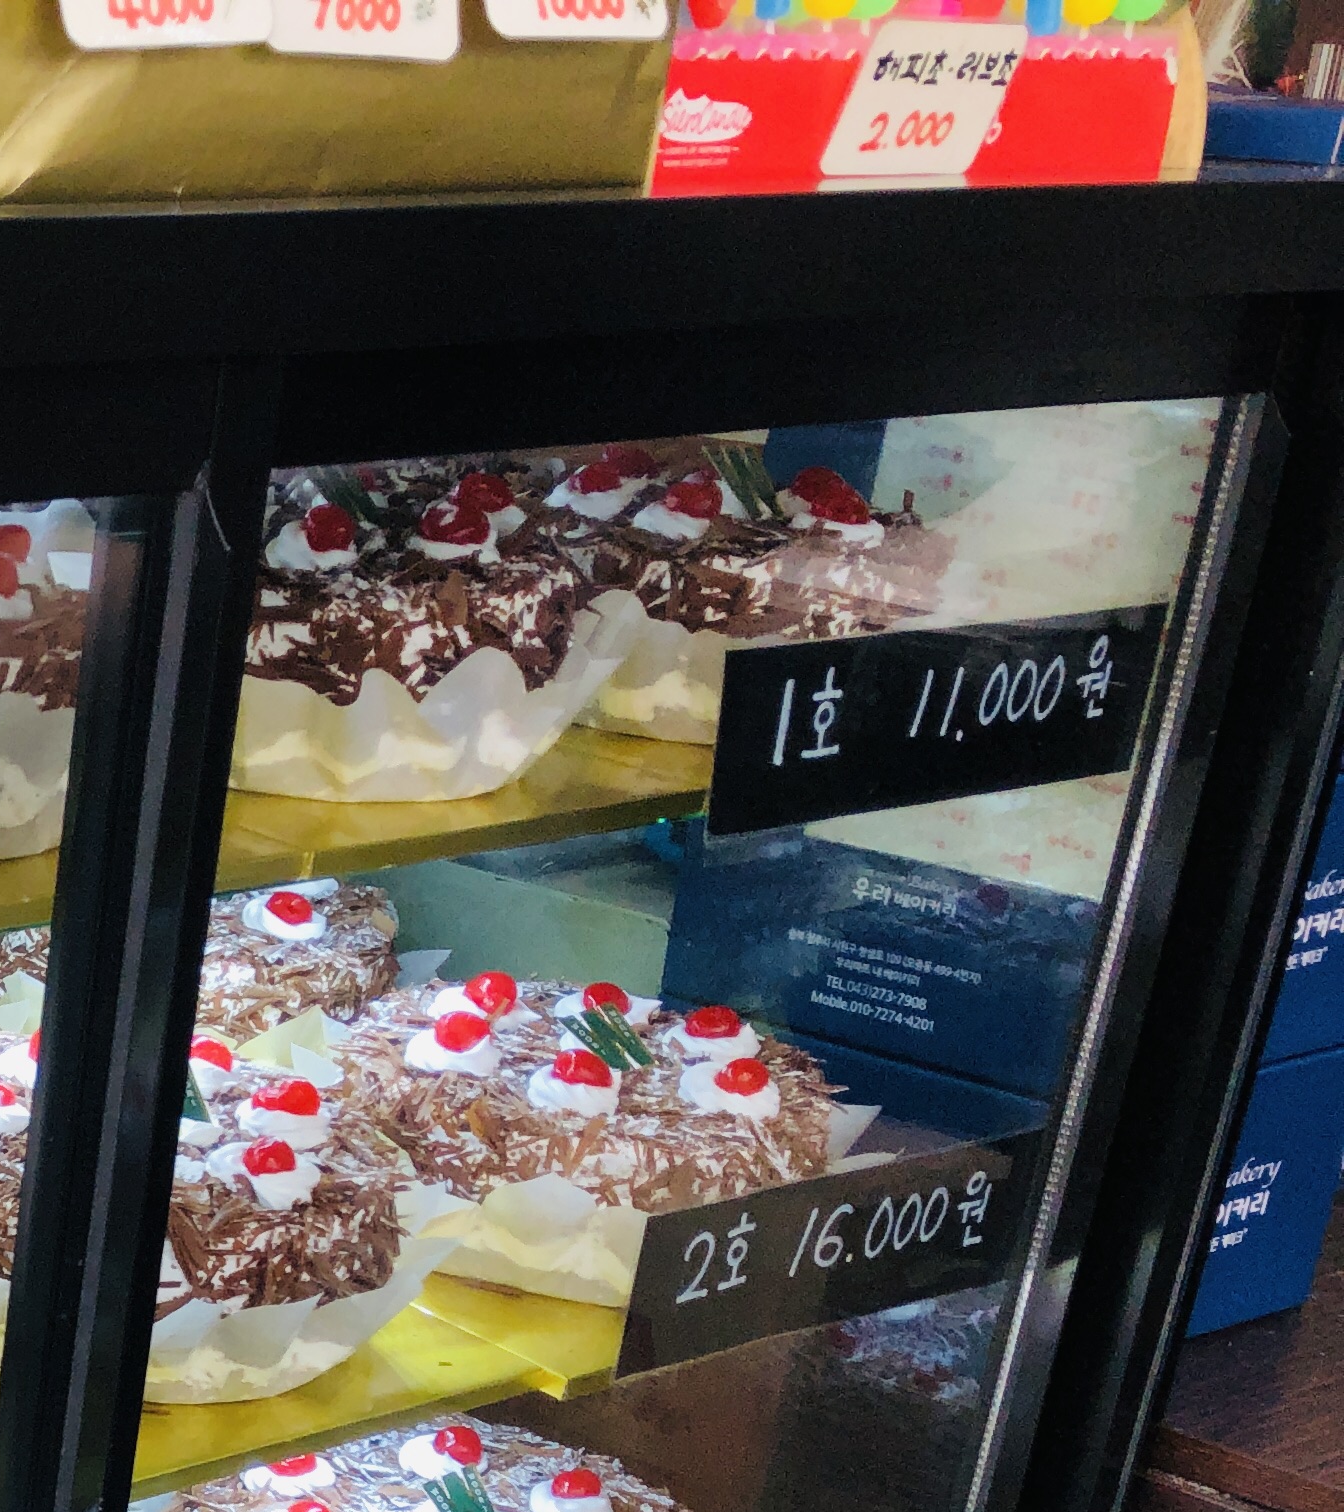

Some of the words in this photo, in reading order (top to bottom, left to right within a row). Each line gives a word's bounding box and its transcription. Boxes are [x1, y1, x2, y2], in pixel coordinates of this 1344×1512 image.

[772, 666, 843, 766] 1호
[1226, 1157, 1282, 1188] akery
[675, 1212, 757, 1304] 2호
